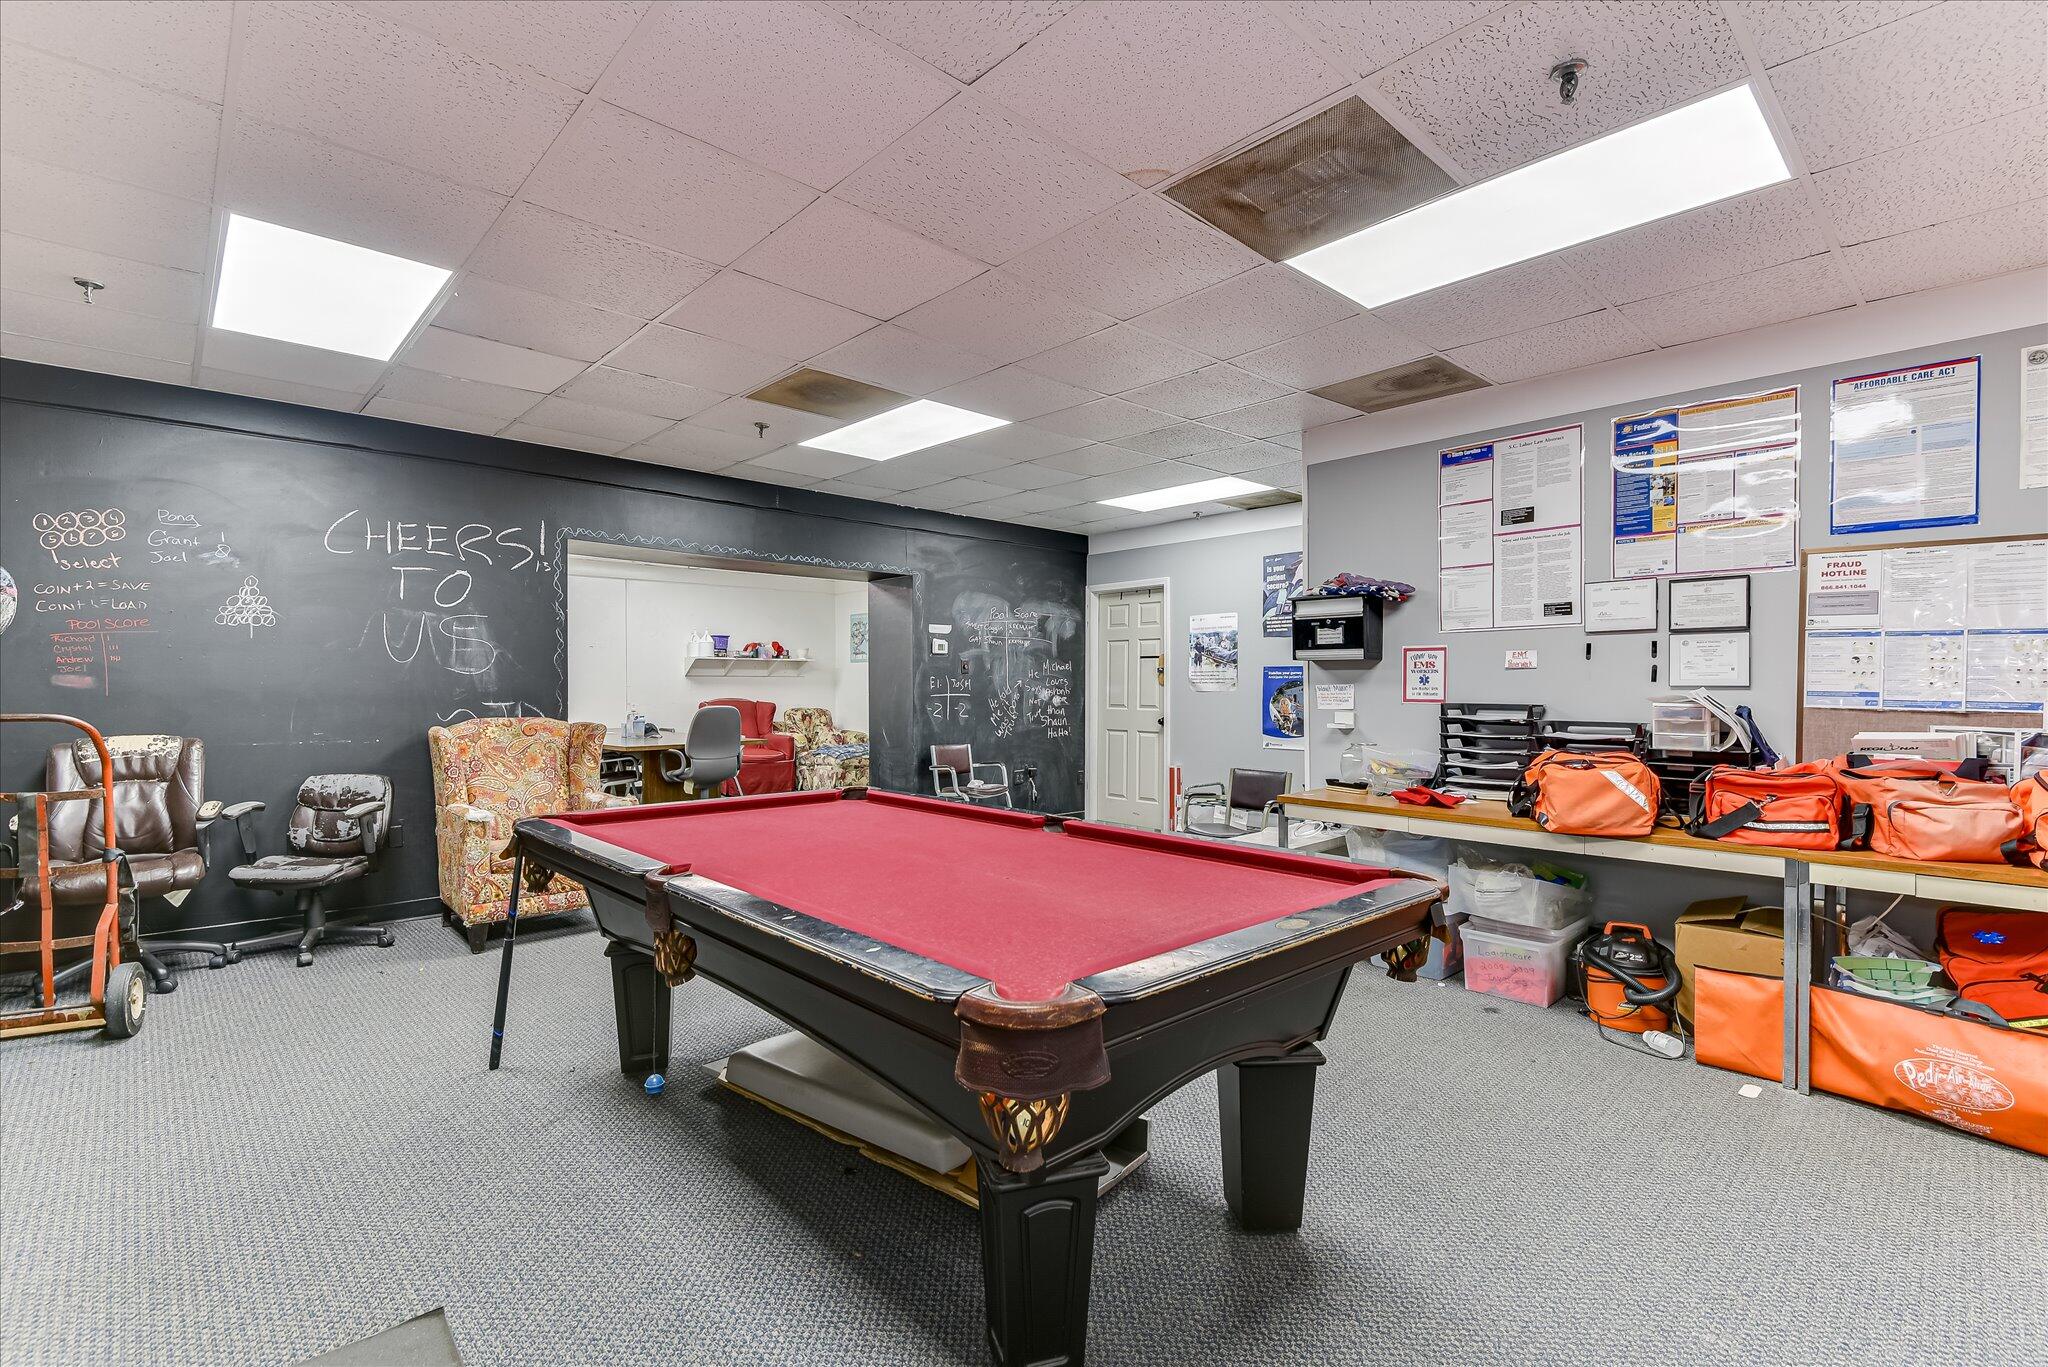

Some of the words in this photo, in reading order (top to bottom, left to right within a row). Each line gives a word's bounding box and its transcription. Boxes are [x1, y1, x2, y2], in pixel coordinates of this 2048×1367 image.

[1853, 374, 1908, 390] AFFORDABLE
[1911, 370, 1935, 381] CARE
[1938, 366, 1957, 376] ACT
[157, 509, 196, 523] Pong
[148, 530, 201, 547] Grant
[60, 552, 122, 570] select
[150, 551, 188, 563] Joel
[1827, 560, 1862, 569] FRAUD
[1266, 574, 1286, 582] patient
[1821, 569, 1867, 577] HOTLINE
[110, 581, 152, 593] SAVE
[392, 566, 472, 607] TO
[1266, 581, 1289, 591] secure?
[111, 598, 148, 611] LOAD
[989, 606, 1009, 620] Pool
[1013, 607, 1039, 619] Score
[51, 633, 96, 643] Richard
[55, 656, 94, 664] Andrew
[1413, 661, 1436, 669] EMS
[1042, 659, 1072, 676] Michael
